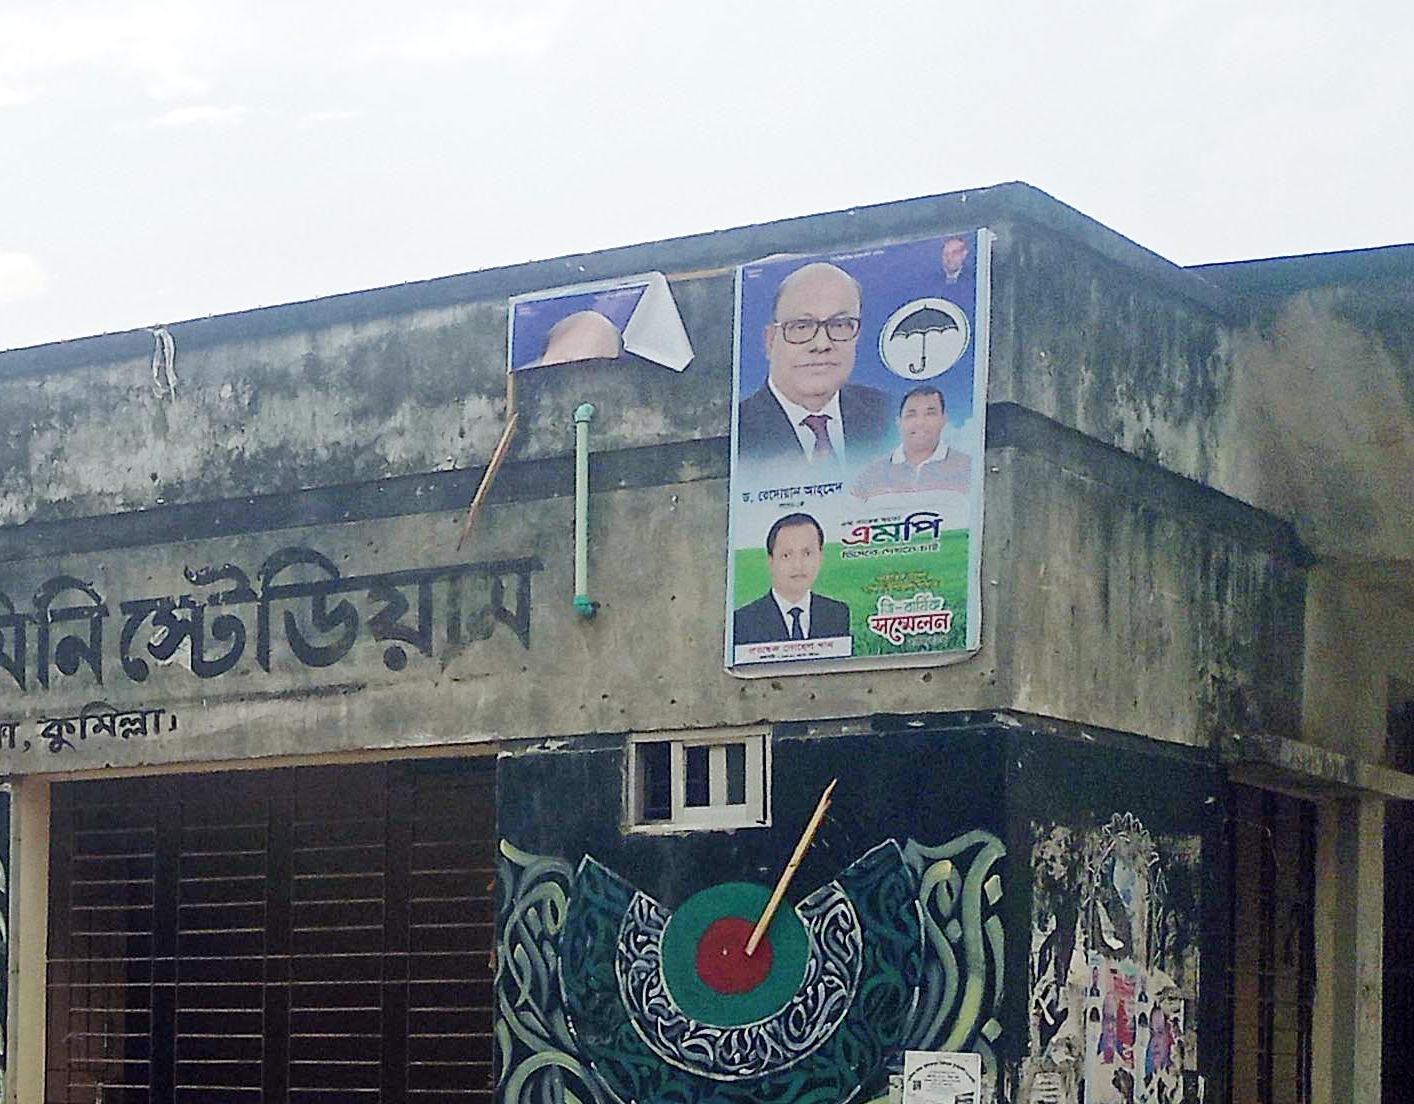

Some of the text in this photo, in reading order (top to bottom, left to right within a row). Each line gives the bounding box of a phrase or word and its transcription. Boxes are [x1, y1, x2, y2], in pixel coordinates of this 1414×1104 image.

[841, 511, 944, 545] এমপি
[119, 546, 545, 683] স্টেডিয়াম
[870, 613, 951, 642] সম্মেলন
